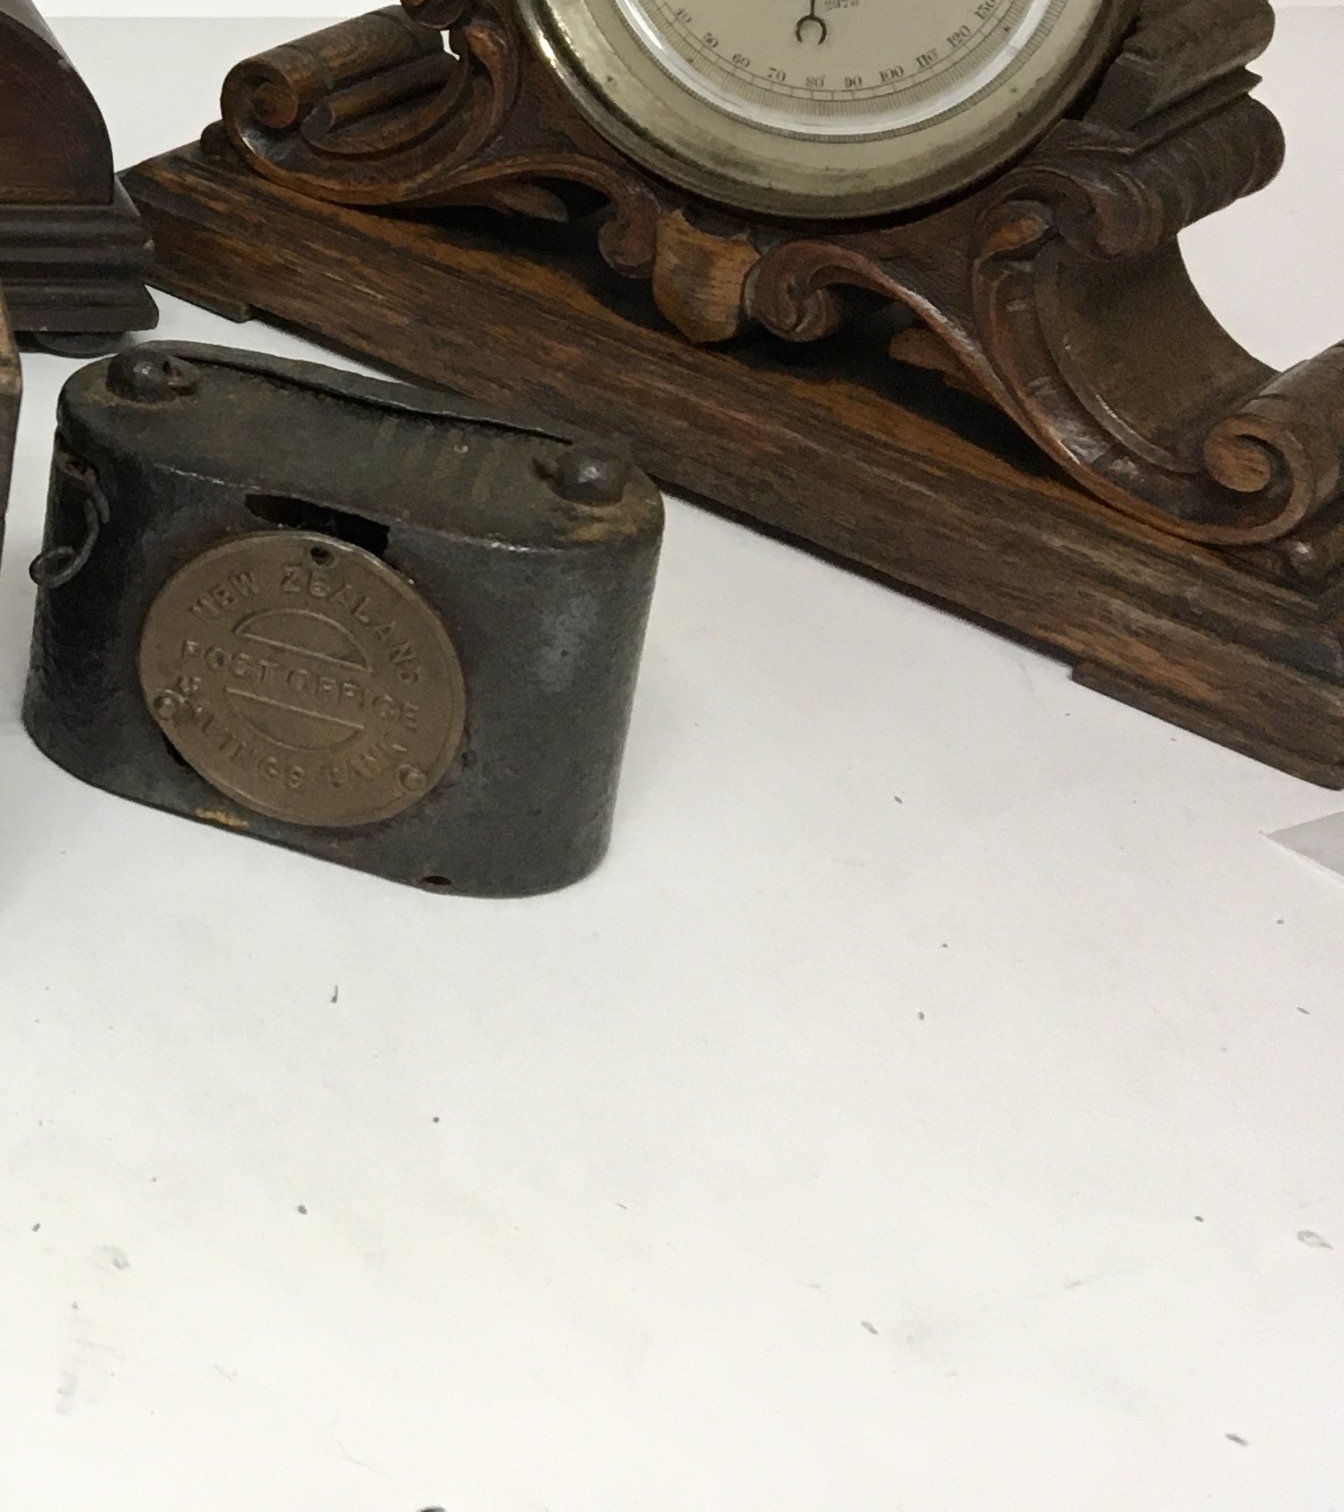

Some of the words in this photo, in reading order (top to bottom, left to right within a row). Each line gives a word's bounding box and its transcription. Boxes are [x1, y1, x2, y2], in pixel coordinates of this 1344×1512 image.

[731, 52, 752, 69] 60
[767, 65, 787, 83] 70
[877, 64, 905, 84] 100
[187, 571, 260, 626] NEW
[279, 561, 420, 685] ZEALAND
[180, 639, 280, 683] POST
[285, 668, 421, 731] OFFICE
